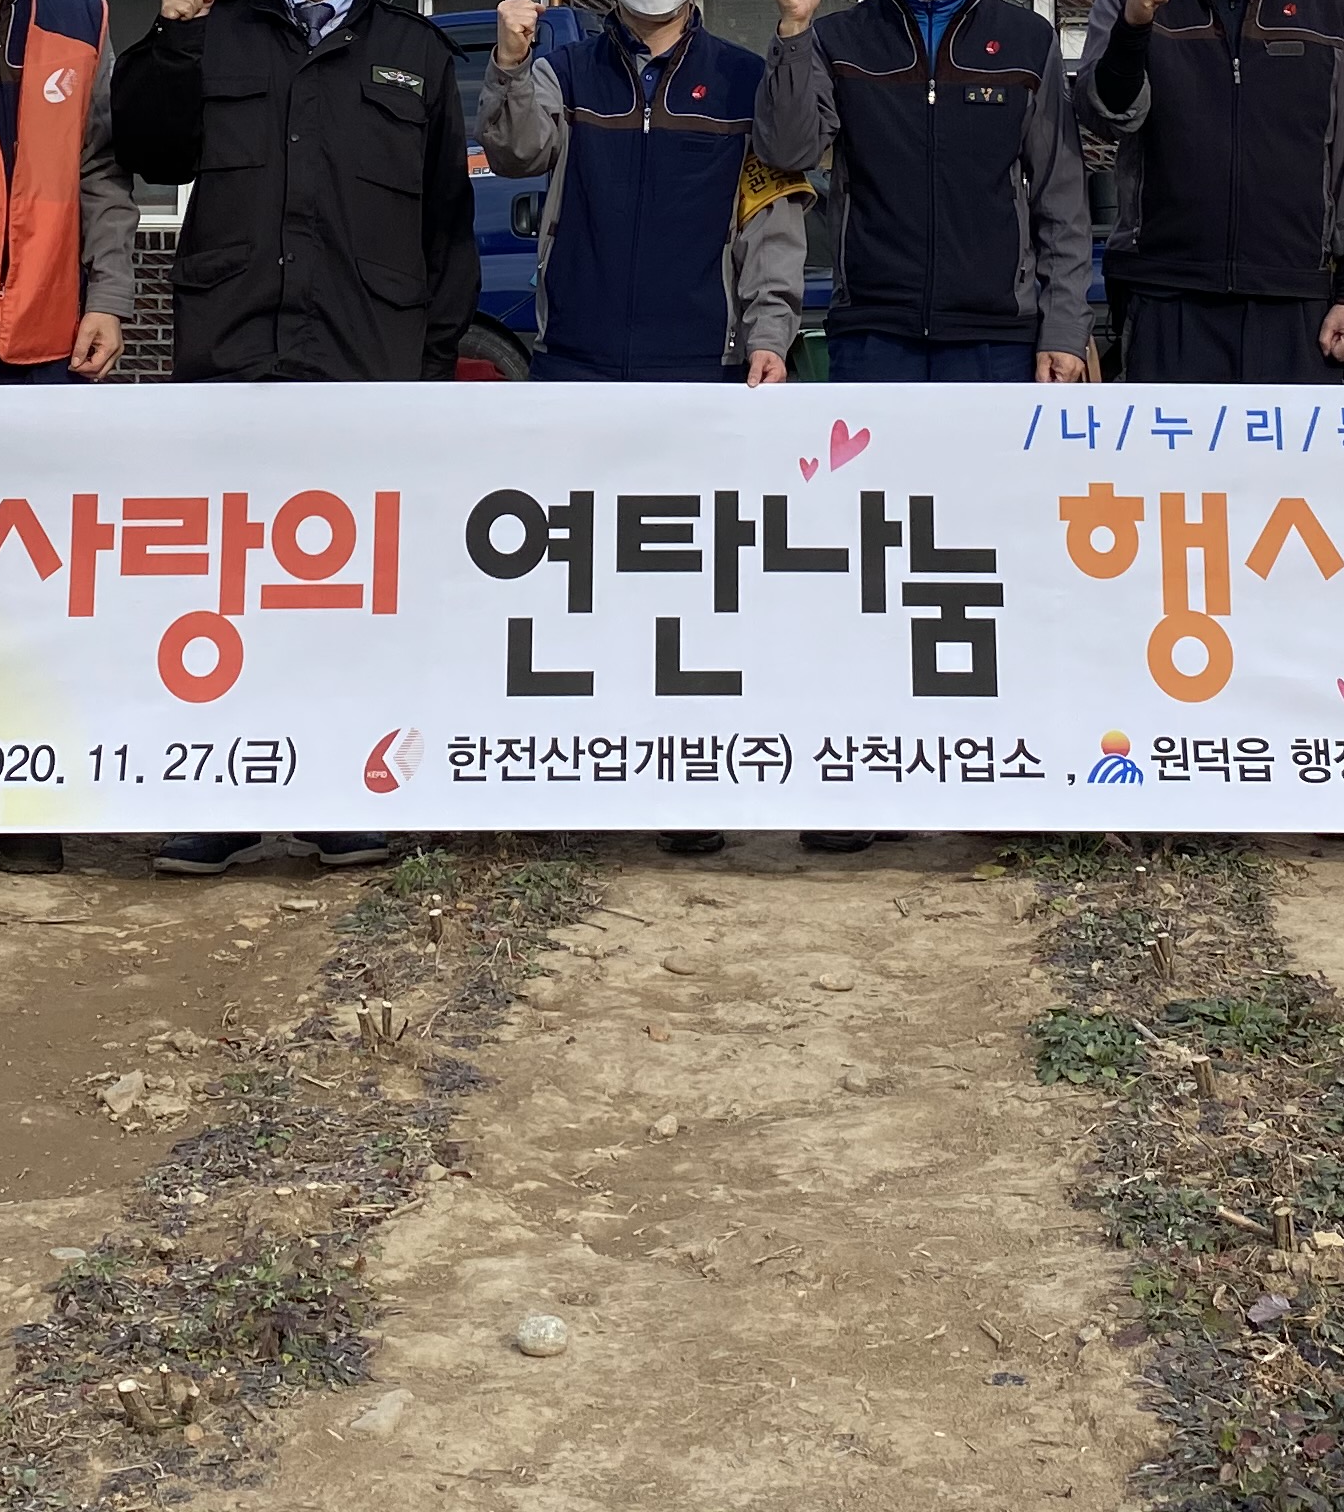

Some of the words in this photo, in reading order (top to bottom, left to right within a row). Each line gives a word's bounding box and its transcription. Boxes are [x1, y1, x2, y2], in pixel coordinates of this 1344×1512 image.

[465, 489, 1004, 697] 연탄나눔
[89, 744, 143, 783] 11.
[163, 736, 296, 785] 27.(금)
[447, 733, 792, 783] 한전산업개발(주)
[812, 735, 1045, 782] 삼척사업소
[1150, 736, 1275, 782] 원덕읍
